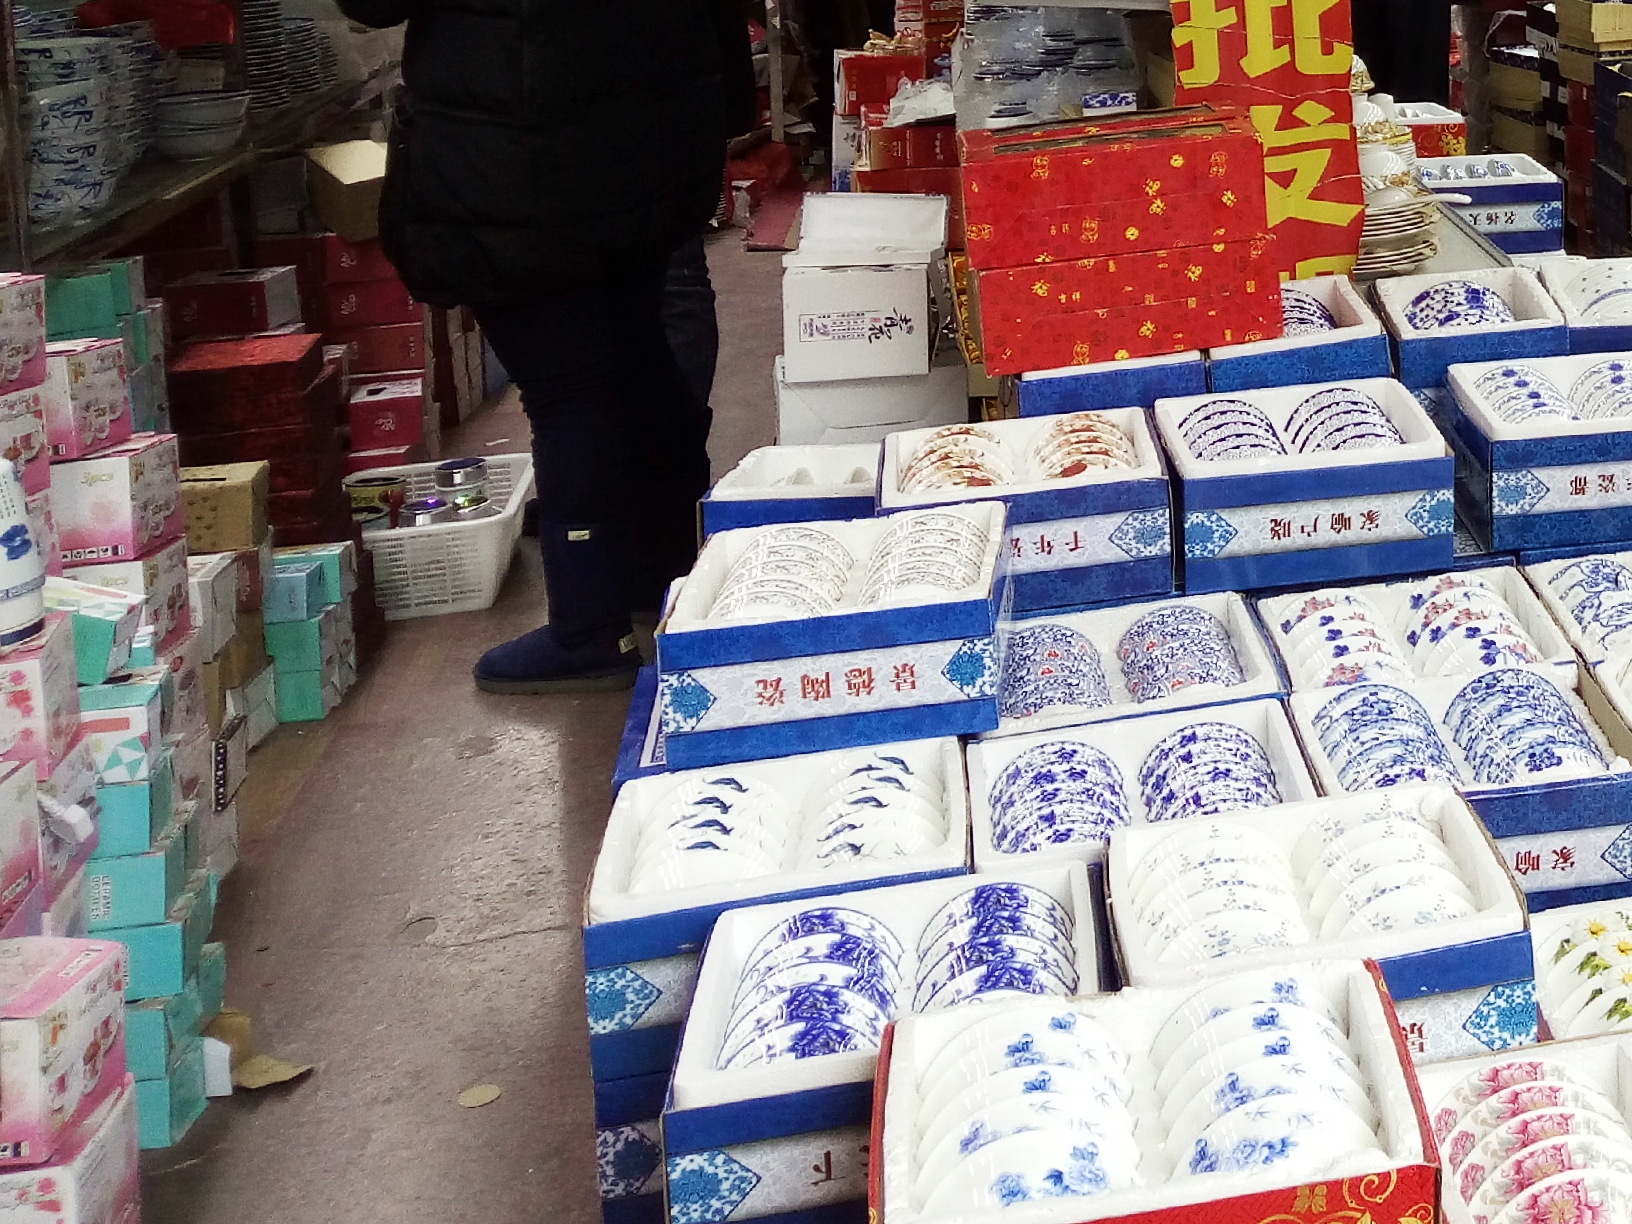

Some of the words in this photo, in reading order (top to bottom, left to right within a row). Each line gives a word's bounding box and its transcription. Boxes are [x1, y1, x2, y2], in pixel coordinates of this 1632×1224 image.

[1269, 509, 1380, 540] 家喻户晓
[754, 663, 916, 707] 景德陶瓷
[1514, 845, 1577, 876] 家喻
